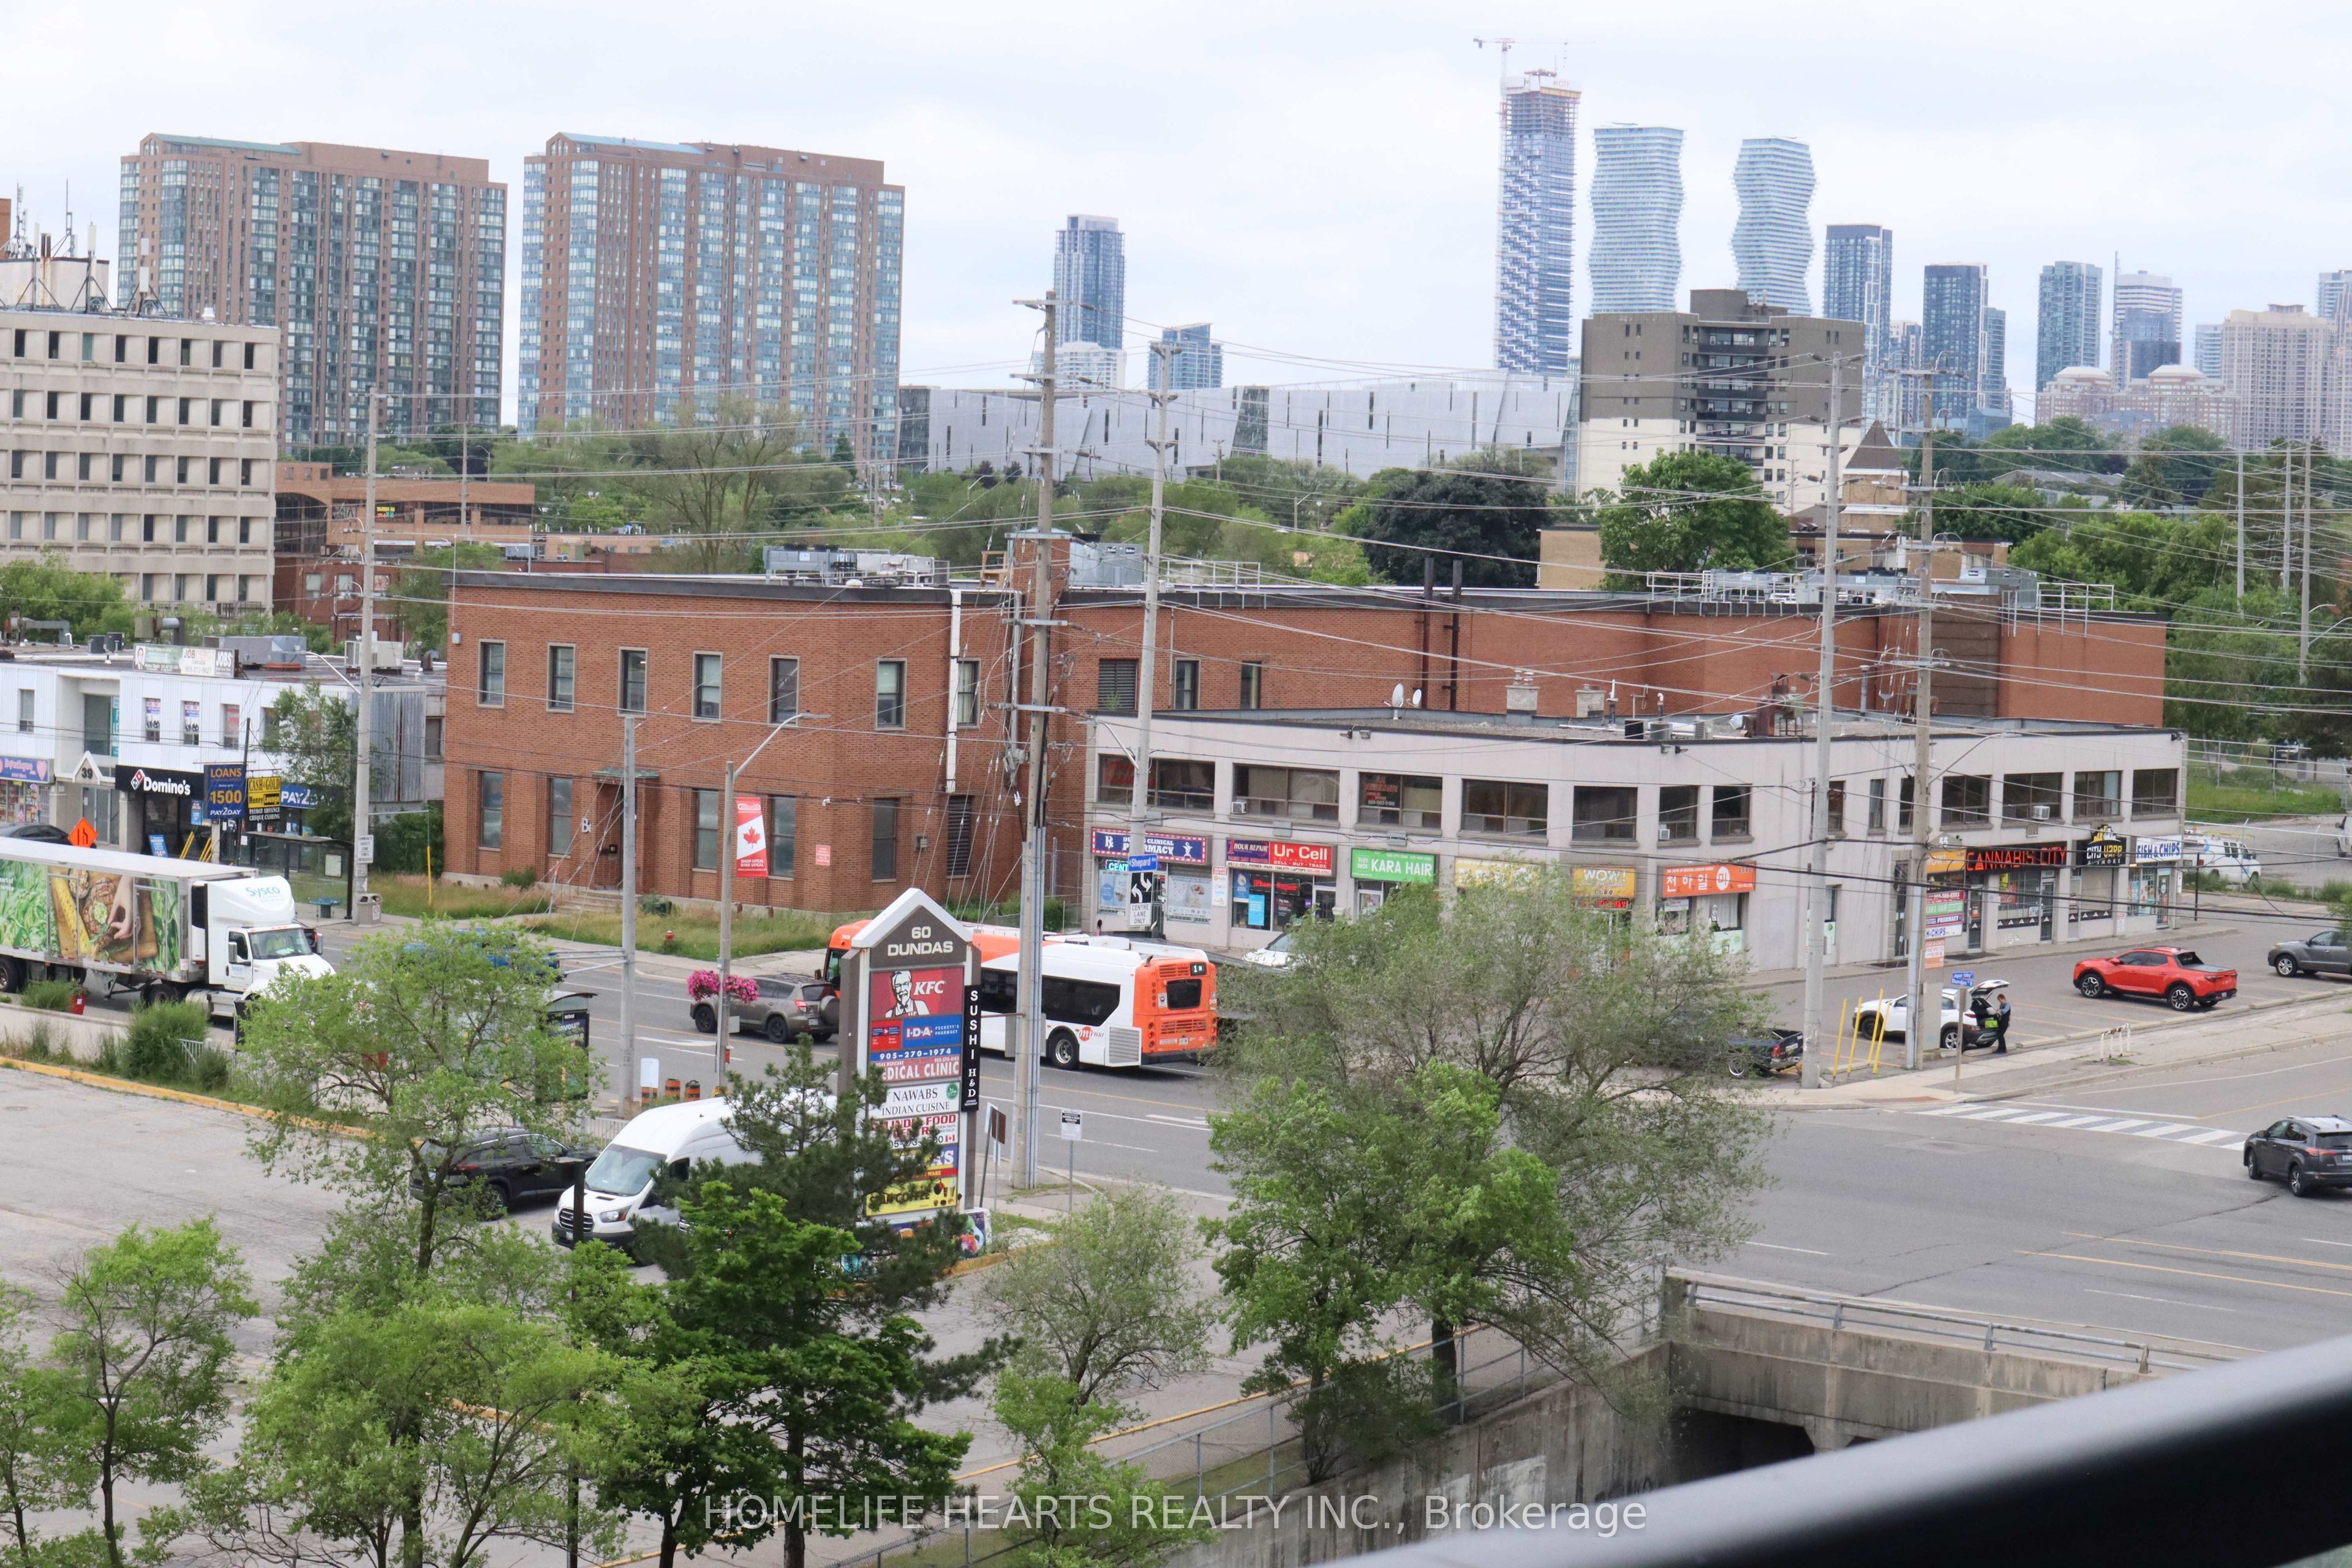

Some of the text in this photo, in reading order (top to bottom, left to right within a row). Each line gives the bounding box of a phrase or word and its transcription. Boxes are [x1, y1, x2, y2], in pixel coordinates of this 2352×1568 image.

[81, 767, 92, 779] 39
[210, 768, 242, 778] LOANS
[143, 778, 190, 796] Domino's
[249, 778, 263, 791] CASH
[265, 778, 280, 790] GOLD
[249, 795, 263, 804] Money
[1123, 843, 1174, 856] PRMACY
[1227, 840, 1235, 854] 1
[1274, 843, 1327, 861] Ur Cell
[2136, 842, 2180, 860] FISH & CHIPS
[1131, 858, 1150, 869] Shepard
[1967, 846, 2067, 871] CANNABIS CITY
[1371, 859, 1432, 876] KARA HAIR
[1584, 869, 1627, 881] WOW!
[246, 886, 281, 897] Sysco
[911, 926, 931, 939] 60
[1932, 927, 1946, 938] CHIPS
[888, 941, 954, 956] DUNDAS
[913, 980, 945, 995] KFC
[969, 990, 978, 1060] SUSHI
[880, 1048, 951, 1060] 905-270-1974
[882, 1061, 959, 1080] EDICAL CLINIC
[893, 1088, 938, 1102] NAWABS
[882, 1101, 949, 1116] INDIAN CUISINE
[926, 1114, 956, 1125] FOOD
